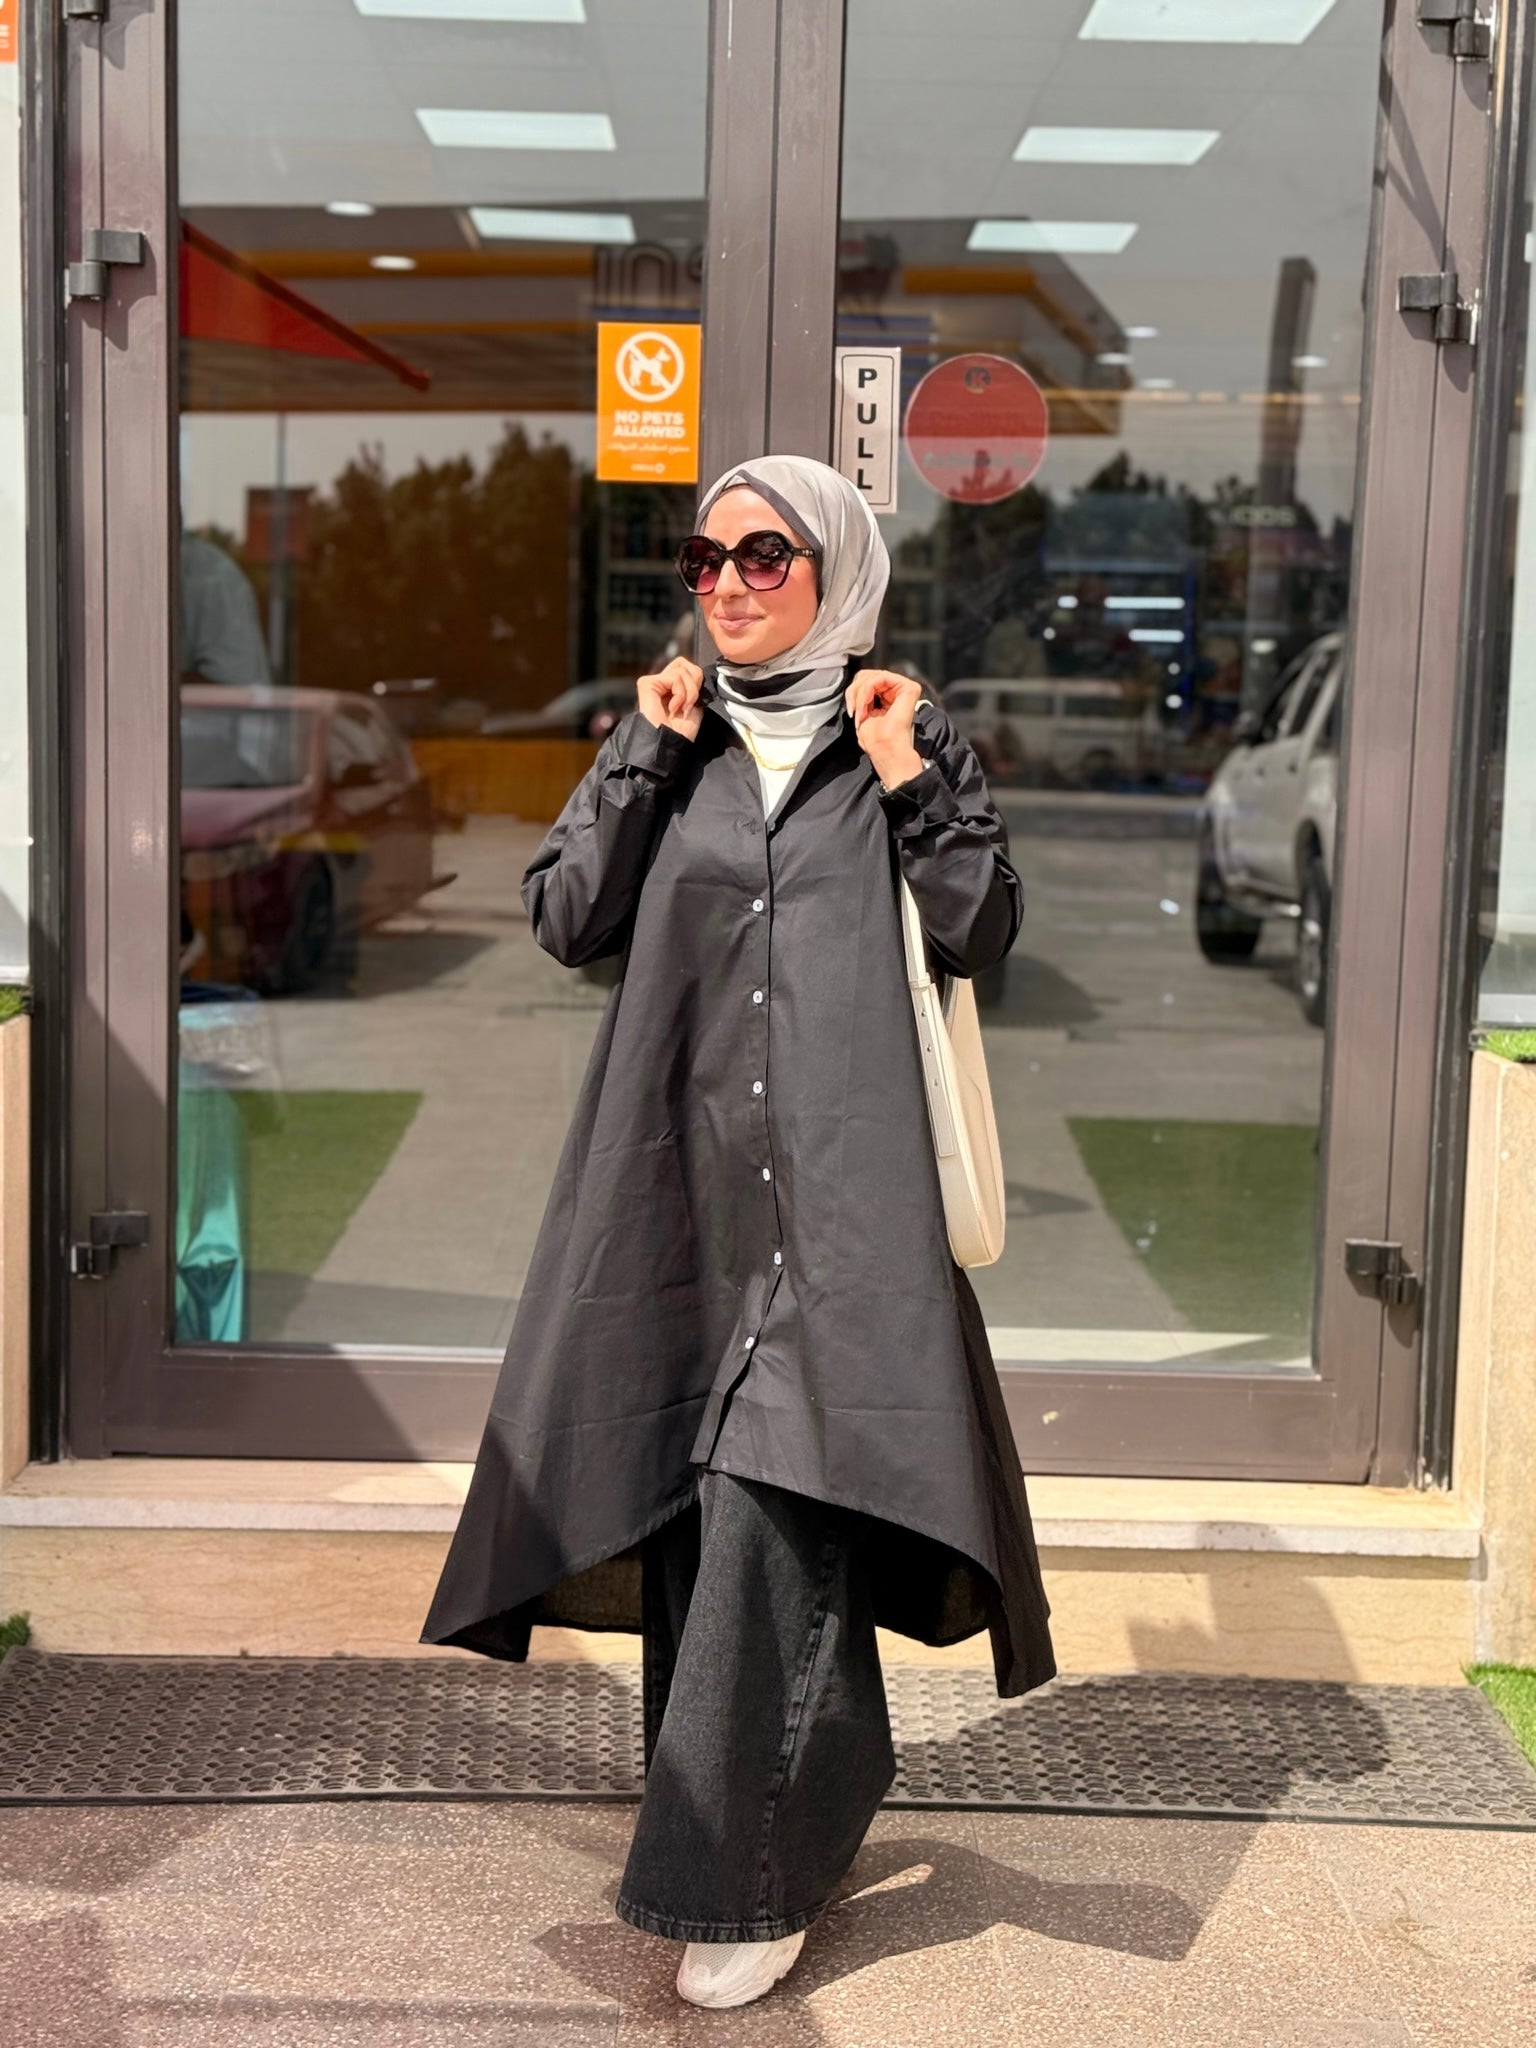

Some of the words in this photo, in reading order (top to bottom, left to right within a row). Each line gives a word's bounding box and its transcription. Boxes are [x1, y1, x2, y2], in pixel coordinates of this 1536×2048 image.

[614, 410, 639, 424] NO
[642, 411, 684, 425] PETS
[613, 425, 686, 439] ALLOWED
[857, 368, 878, 490] PULL
